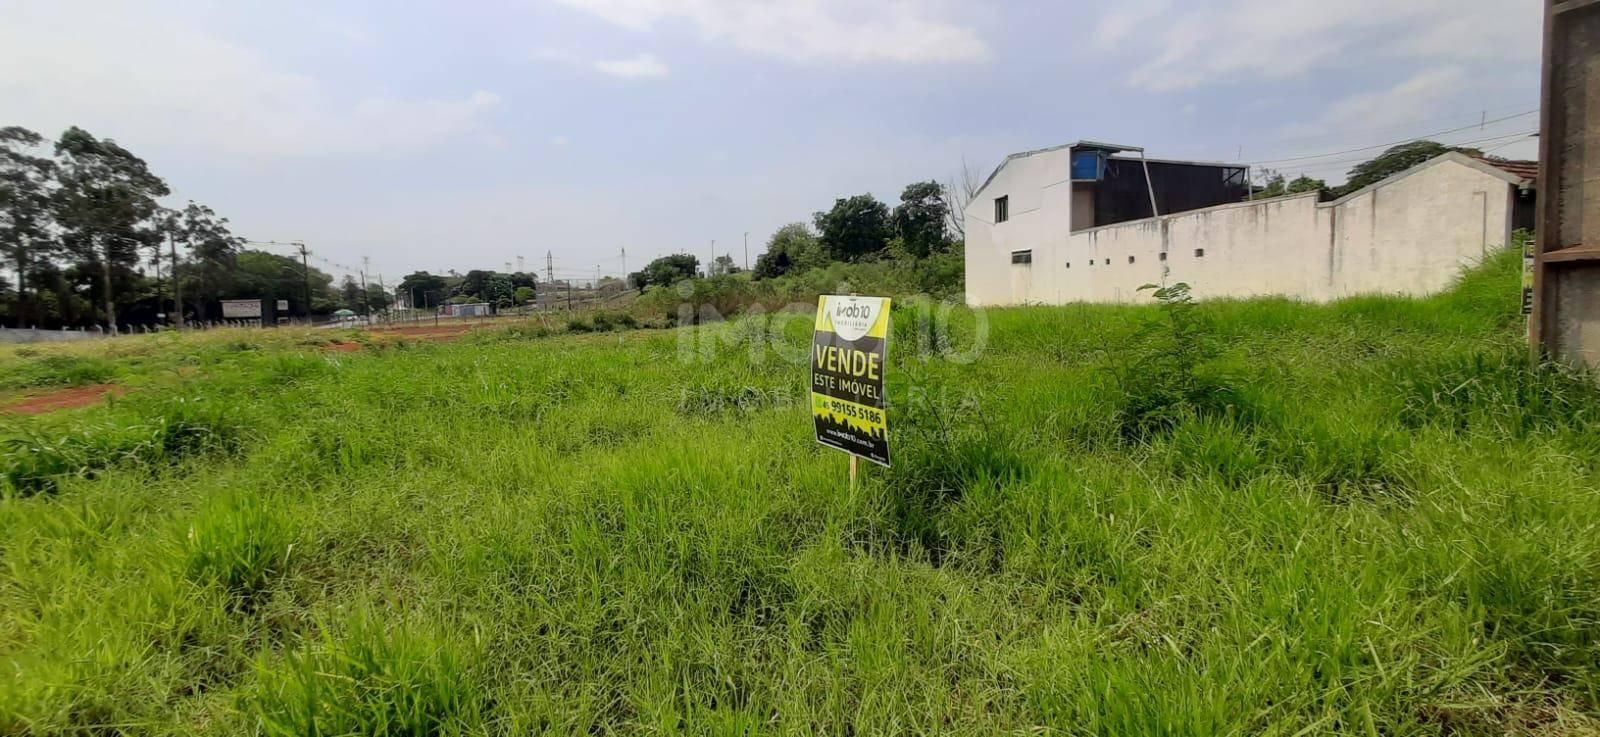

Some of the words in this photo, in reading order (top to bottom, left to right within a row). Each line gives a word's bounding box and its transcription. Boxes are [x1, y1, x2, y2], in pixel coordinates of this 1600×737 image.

[815, 344, 880, 380] VENDE
[814, 373, 836, 390] ESTE
[838, 379, 880, 400] IMÓVEL
[831, 401, 857, 417] 99155
[858, 408, 882, 424] 5186
